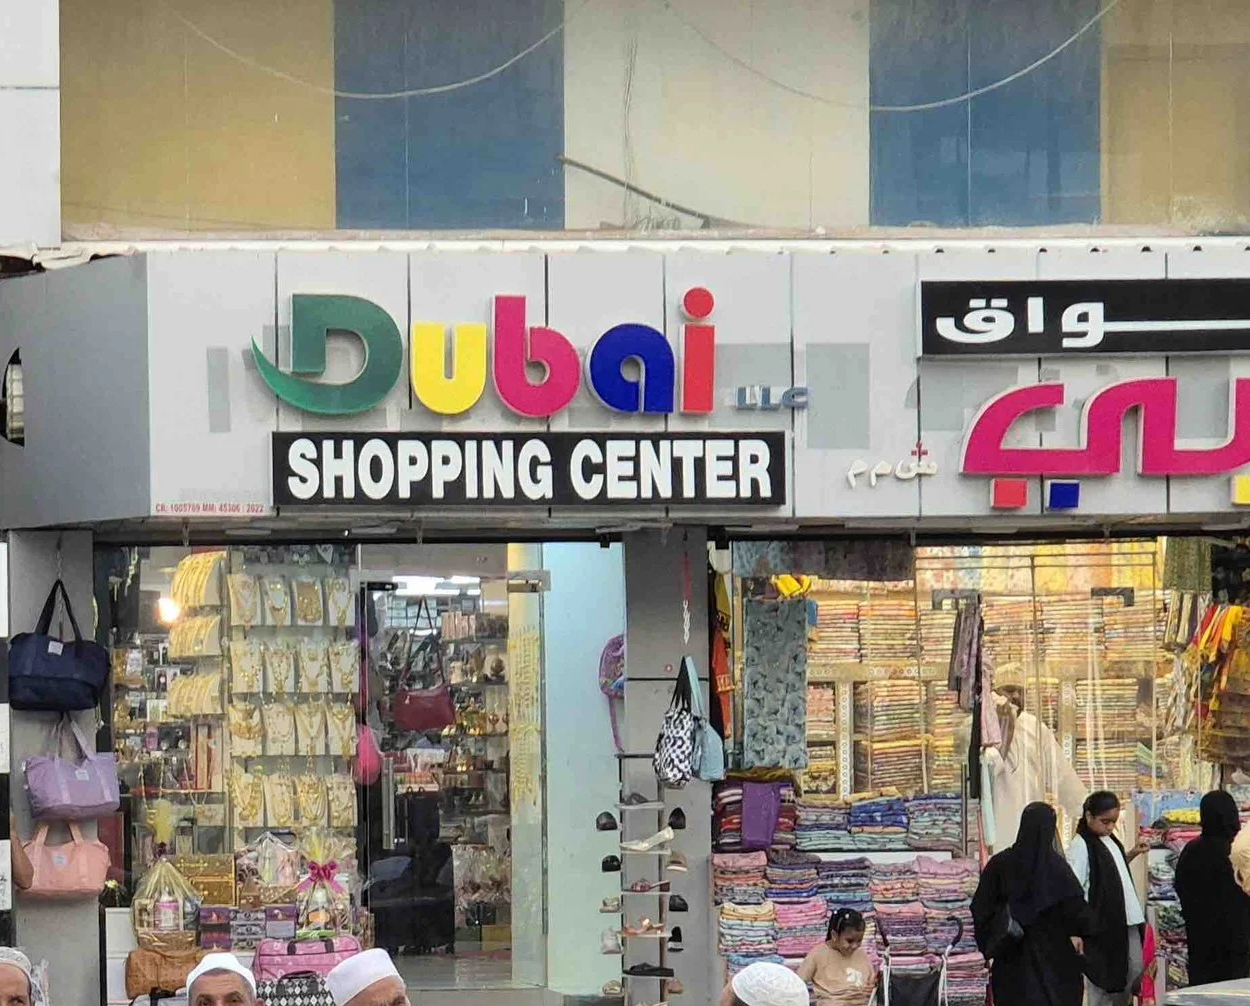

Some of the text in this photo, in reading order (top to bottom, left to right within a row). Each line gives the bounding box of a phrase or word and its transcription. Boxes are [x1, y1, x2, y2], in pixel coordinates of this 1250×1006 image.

[251, 286, 715, 418] Dubai
[935, 296, 1250, 348] واق
[287, 438, 772, 500] SHOPPING CENTER
